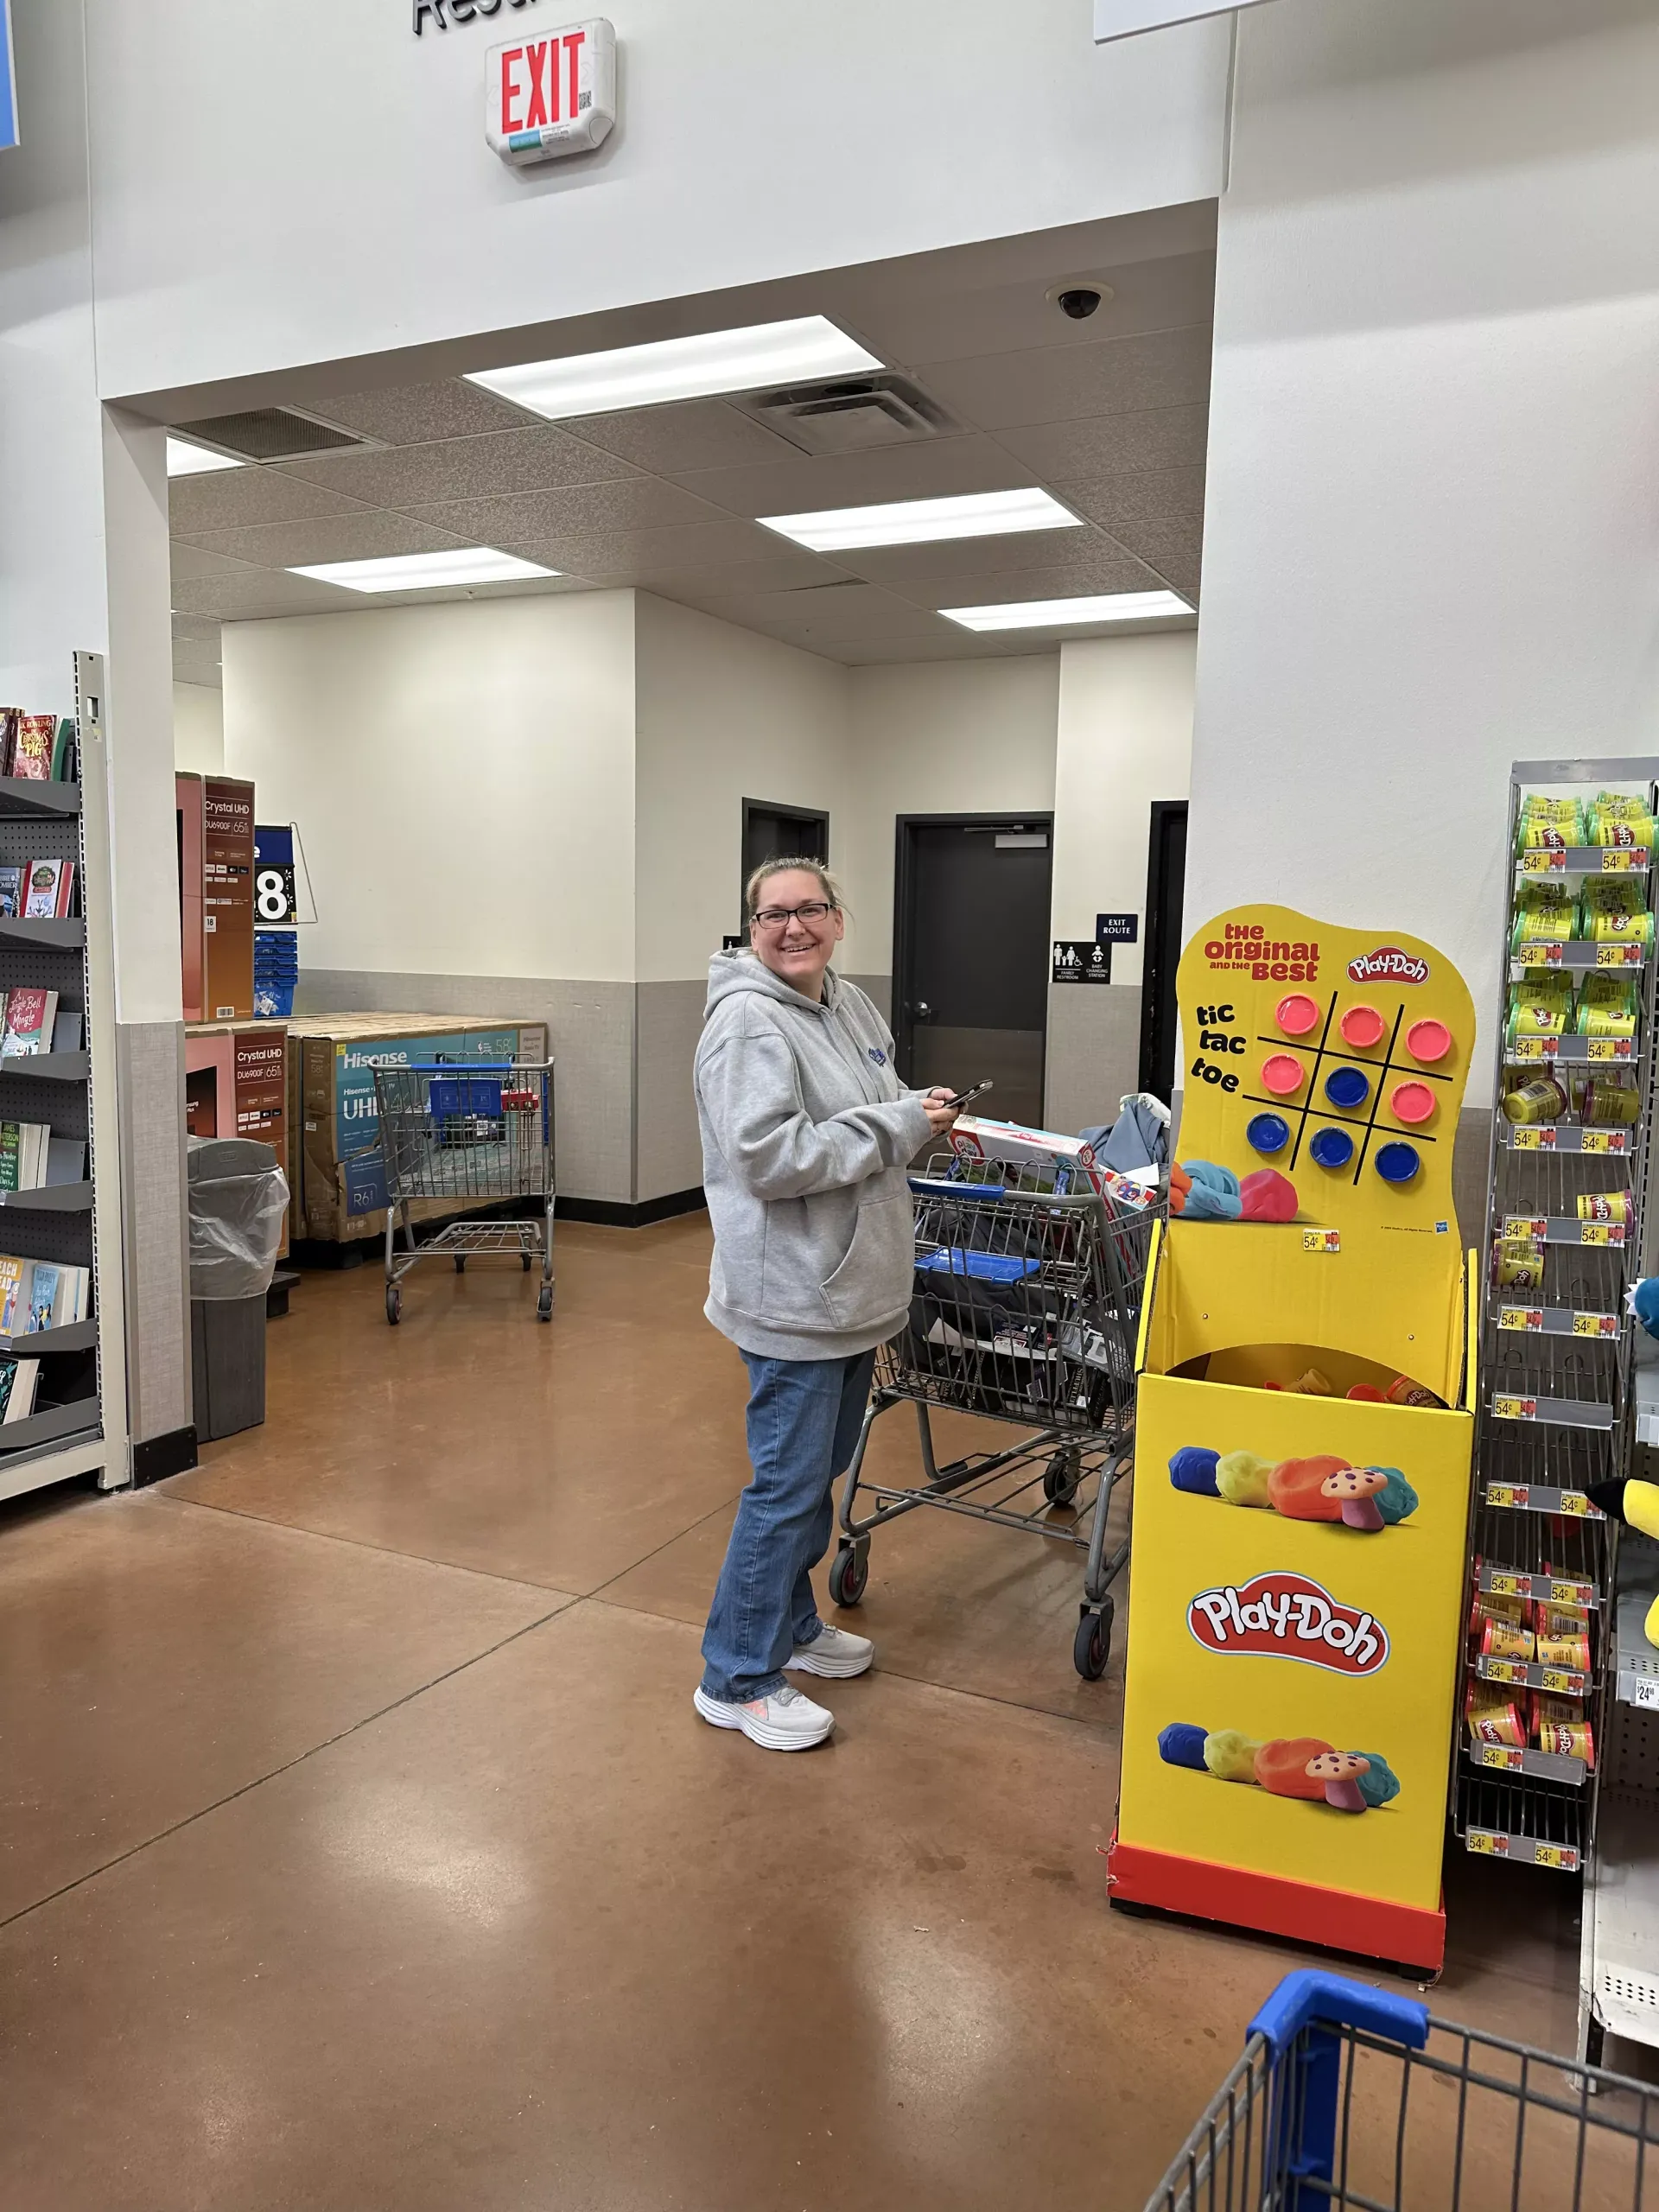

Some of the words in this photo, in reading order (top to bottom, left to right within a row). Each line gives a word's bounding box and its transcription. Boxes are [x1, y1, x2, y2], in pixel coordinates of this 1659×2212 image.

[501, 31, 585, 135] EXIT
[27, 720, 51, 728] ROWLING
[25, 741, 42, 757] PIG
[206, 800, 233, 815] Crystal
[234, 804, 250, 814] UHD
[233, 822, 245, 833] 65
[1349, 953, 1427, 981] Play-Doh
[9, 997, 27, 1013] Jingle
[26, 995, 41, 1011] Bell
[13, 1010, 35, 1028] Mingle
[1196, 1004, 1235, 1026] tic
[1198, 1029, 1247, 1054] tac
[238, 1049, 266, 1064] Crystal
[266, 1048, 282, 1058] UHD
[237, 1068, 264, 1080] DU6900F
[266, 1065, 277, 1077] 65
[1191, 1057, 1240, 1093] toe
[957, 1140, 976, 1151] play
[353, 1192, 370, 1207] R6
[1193, 1586, 1380, 1665] Play-Doh
